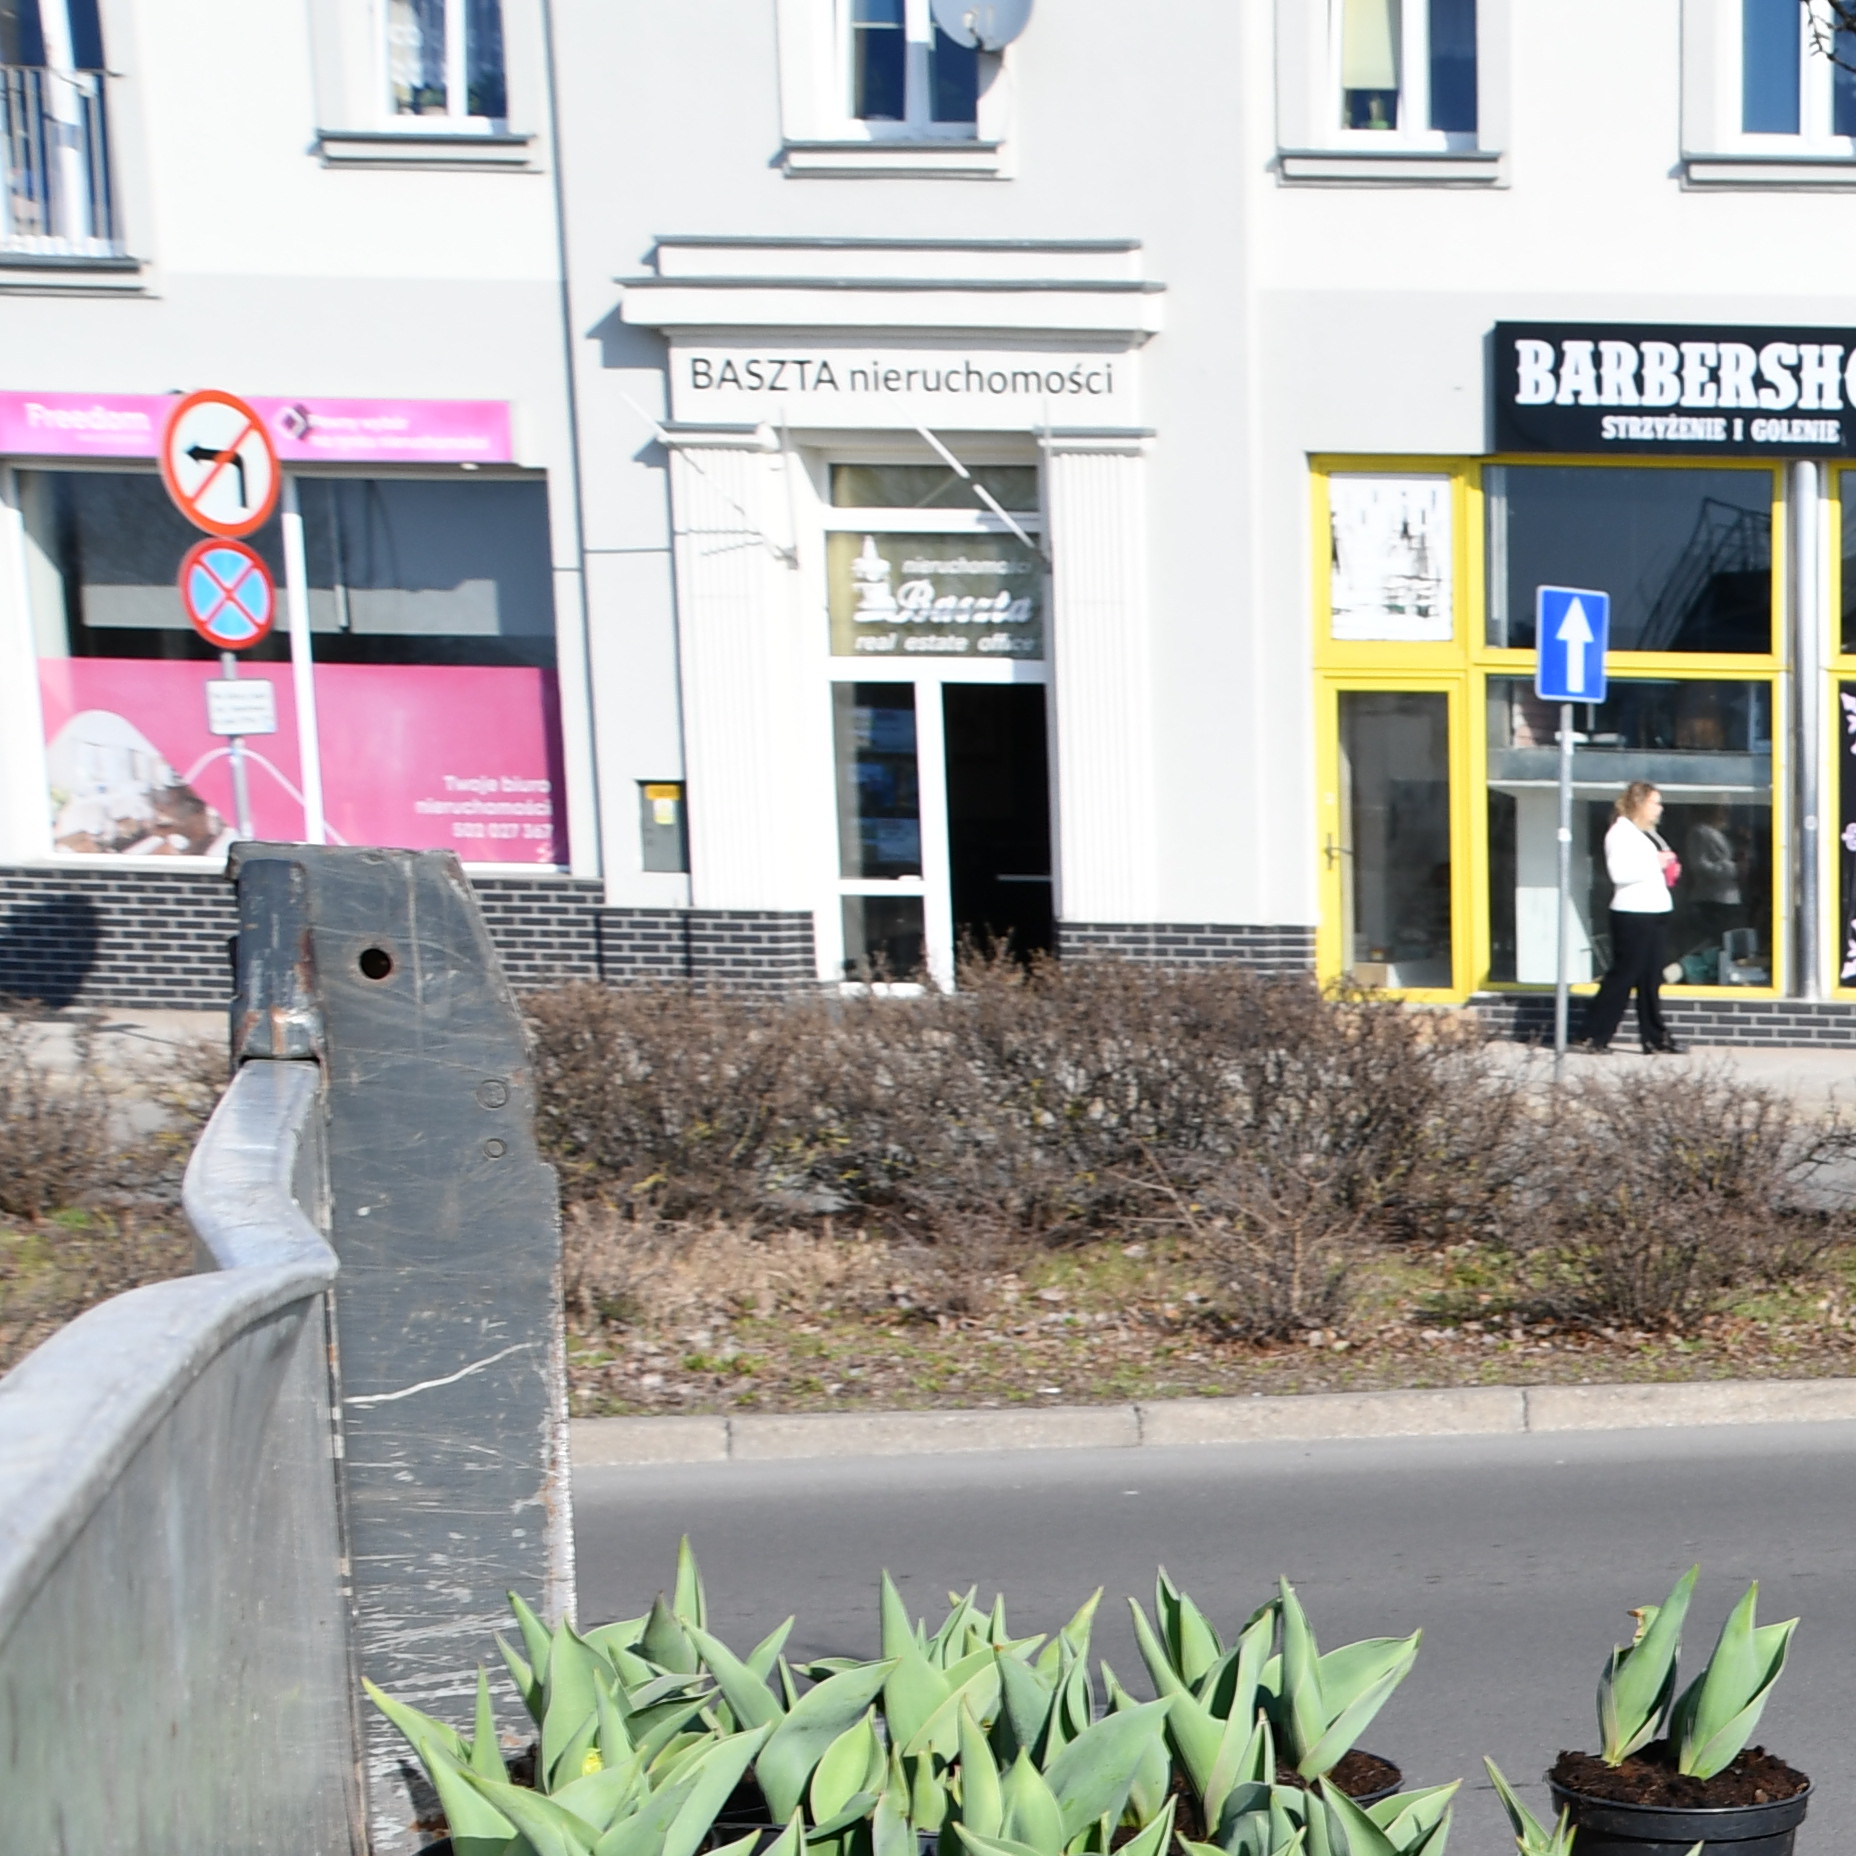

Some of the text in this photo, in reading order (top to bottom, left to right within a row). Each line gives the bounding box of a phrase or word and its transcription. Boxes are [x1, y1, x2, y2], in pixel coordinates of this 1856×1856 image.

[691, 357, 1114, 395] BASZTA nieruchomości
[24, 401, 152, 431] Freedom
[1601, 412, 1841, 443] STRZYŻENIE I GOLENIE
[855, 632, 1034, 652] real estate office
